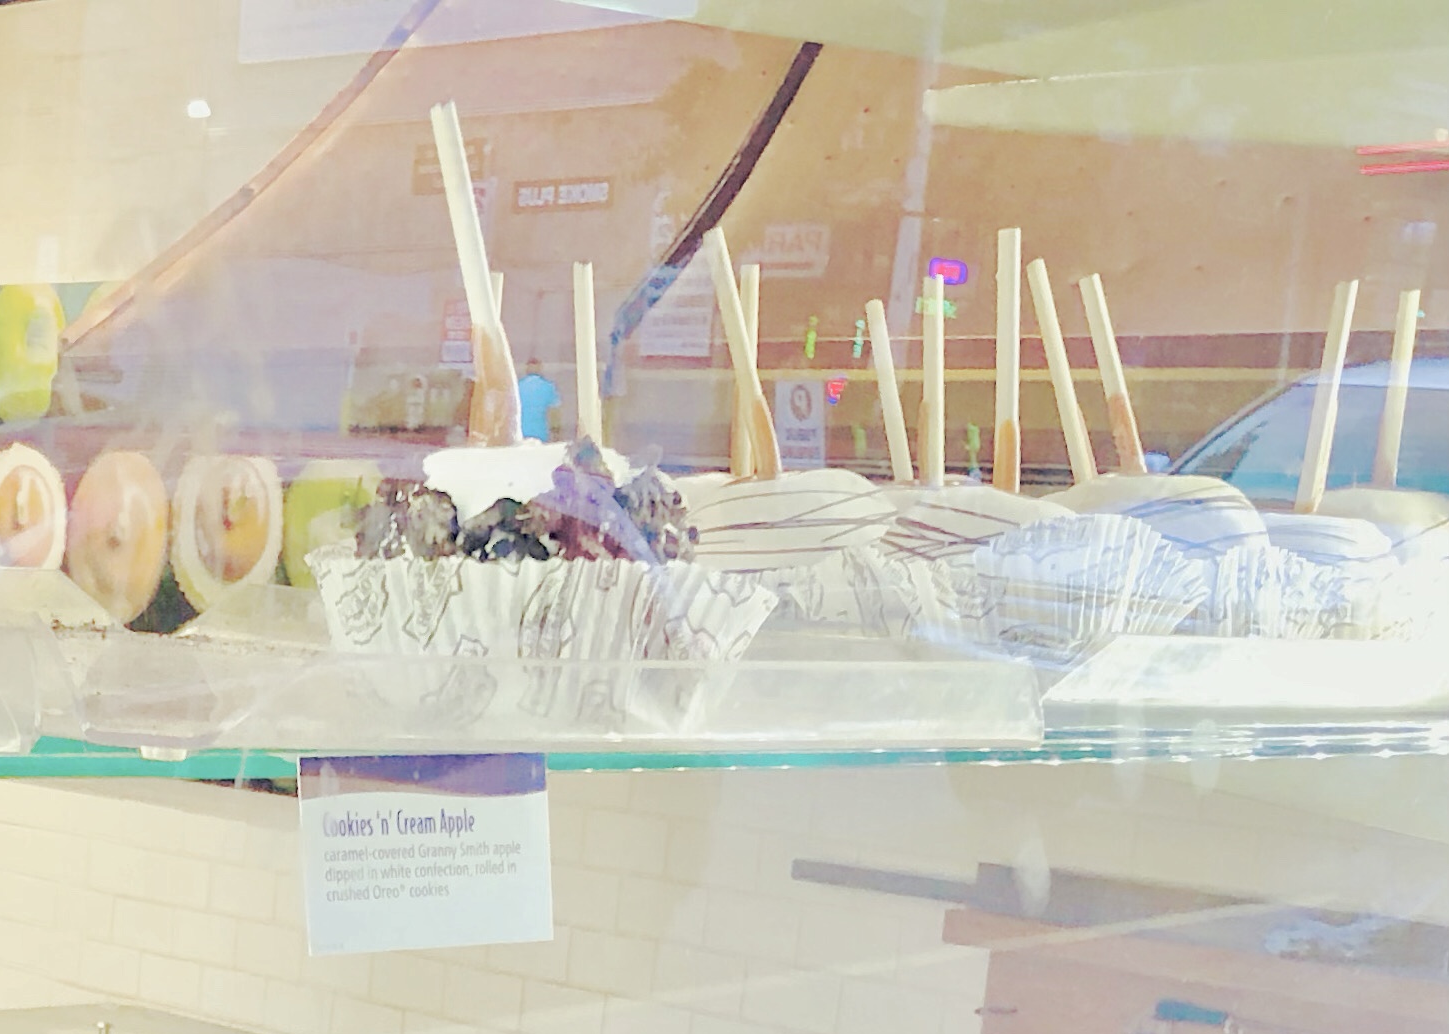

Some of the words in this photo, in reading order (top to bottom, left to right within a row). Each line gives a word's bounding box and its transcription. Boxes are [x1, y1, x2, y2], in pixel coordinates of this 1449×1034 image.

[323, 811, 374, 837] Cookies
[397, 810, 436, 835] Cream
[440, 808, 475, 838] Apple
[324, 845, 415, 862] caramel-covered
[418, 843, 456, 860] Granny
[460, 841, 489, 857] Smith
[493, 840, 521, 858] apple
[380, 864, 412, 880] white
[475, 860, 505, 875] rolled
[507, 861, 517, 873] in
[326, 885, 370, 902] crushed
[409, 883, 450, 898] cookies
